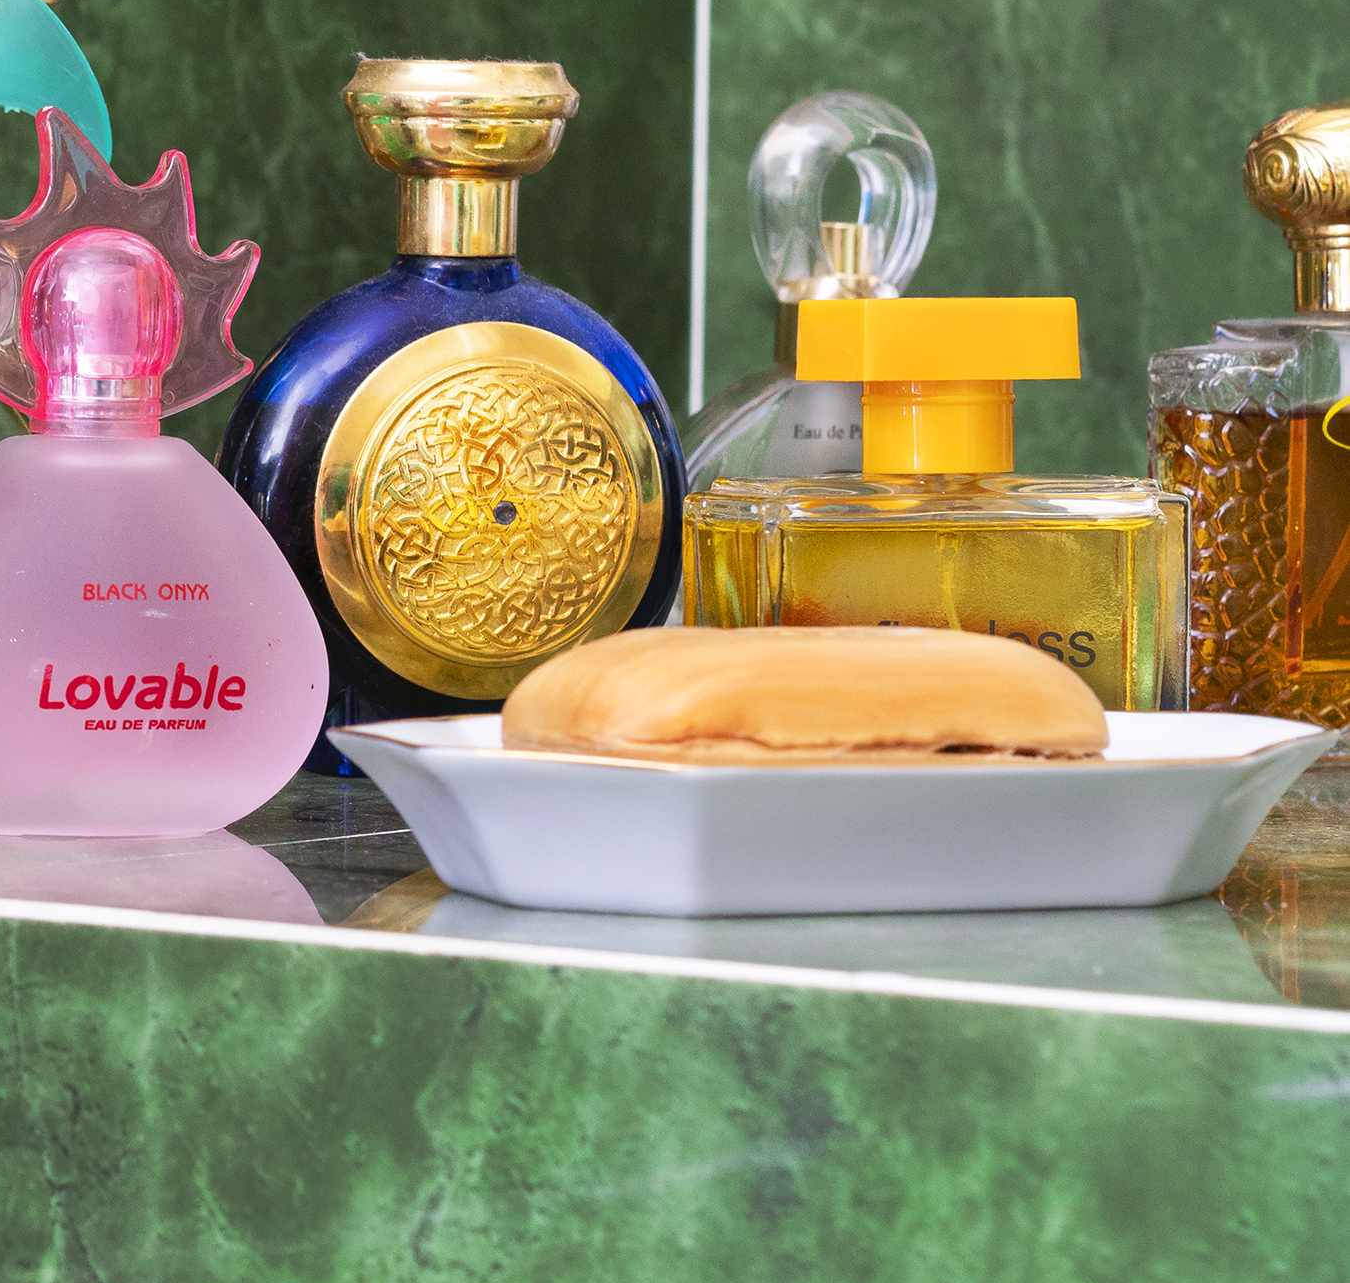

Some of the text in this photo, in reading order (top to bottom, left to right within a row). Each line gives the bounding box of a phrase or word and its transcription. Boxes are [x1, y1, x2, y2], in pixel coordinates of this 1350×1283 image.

[793, 423, 822, 440] Eau
[826, 425, 845, 440] de
[82, 582, 210, 602] BLACK ONYX
[38, 661, 247, 712] Lovable
[84, 719, 207, 731] EAU DE PARFUM
